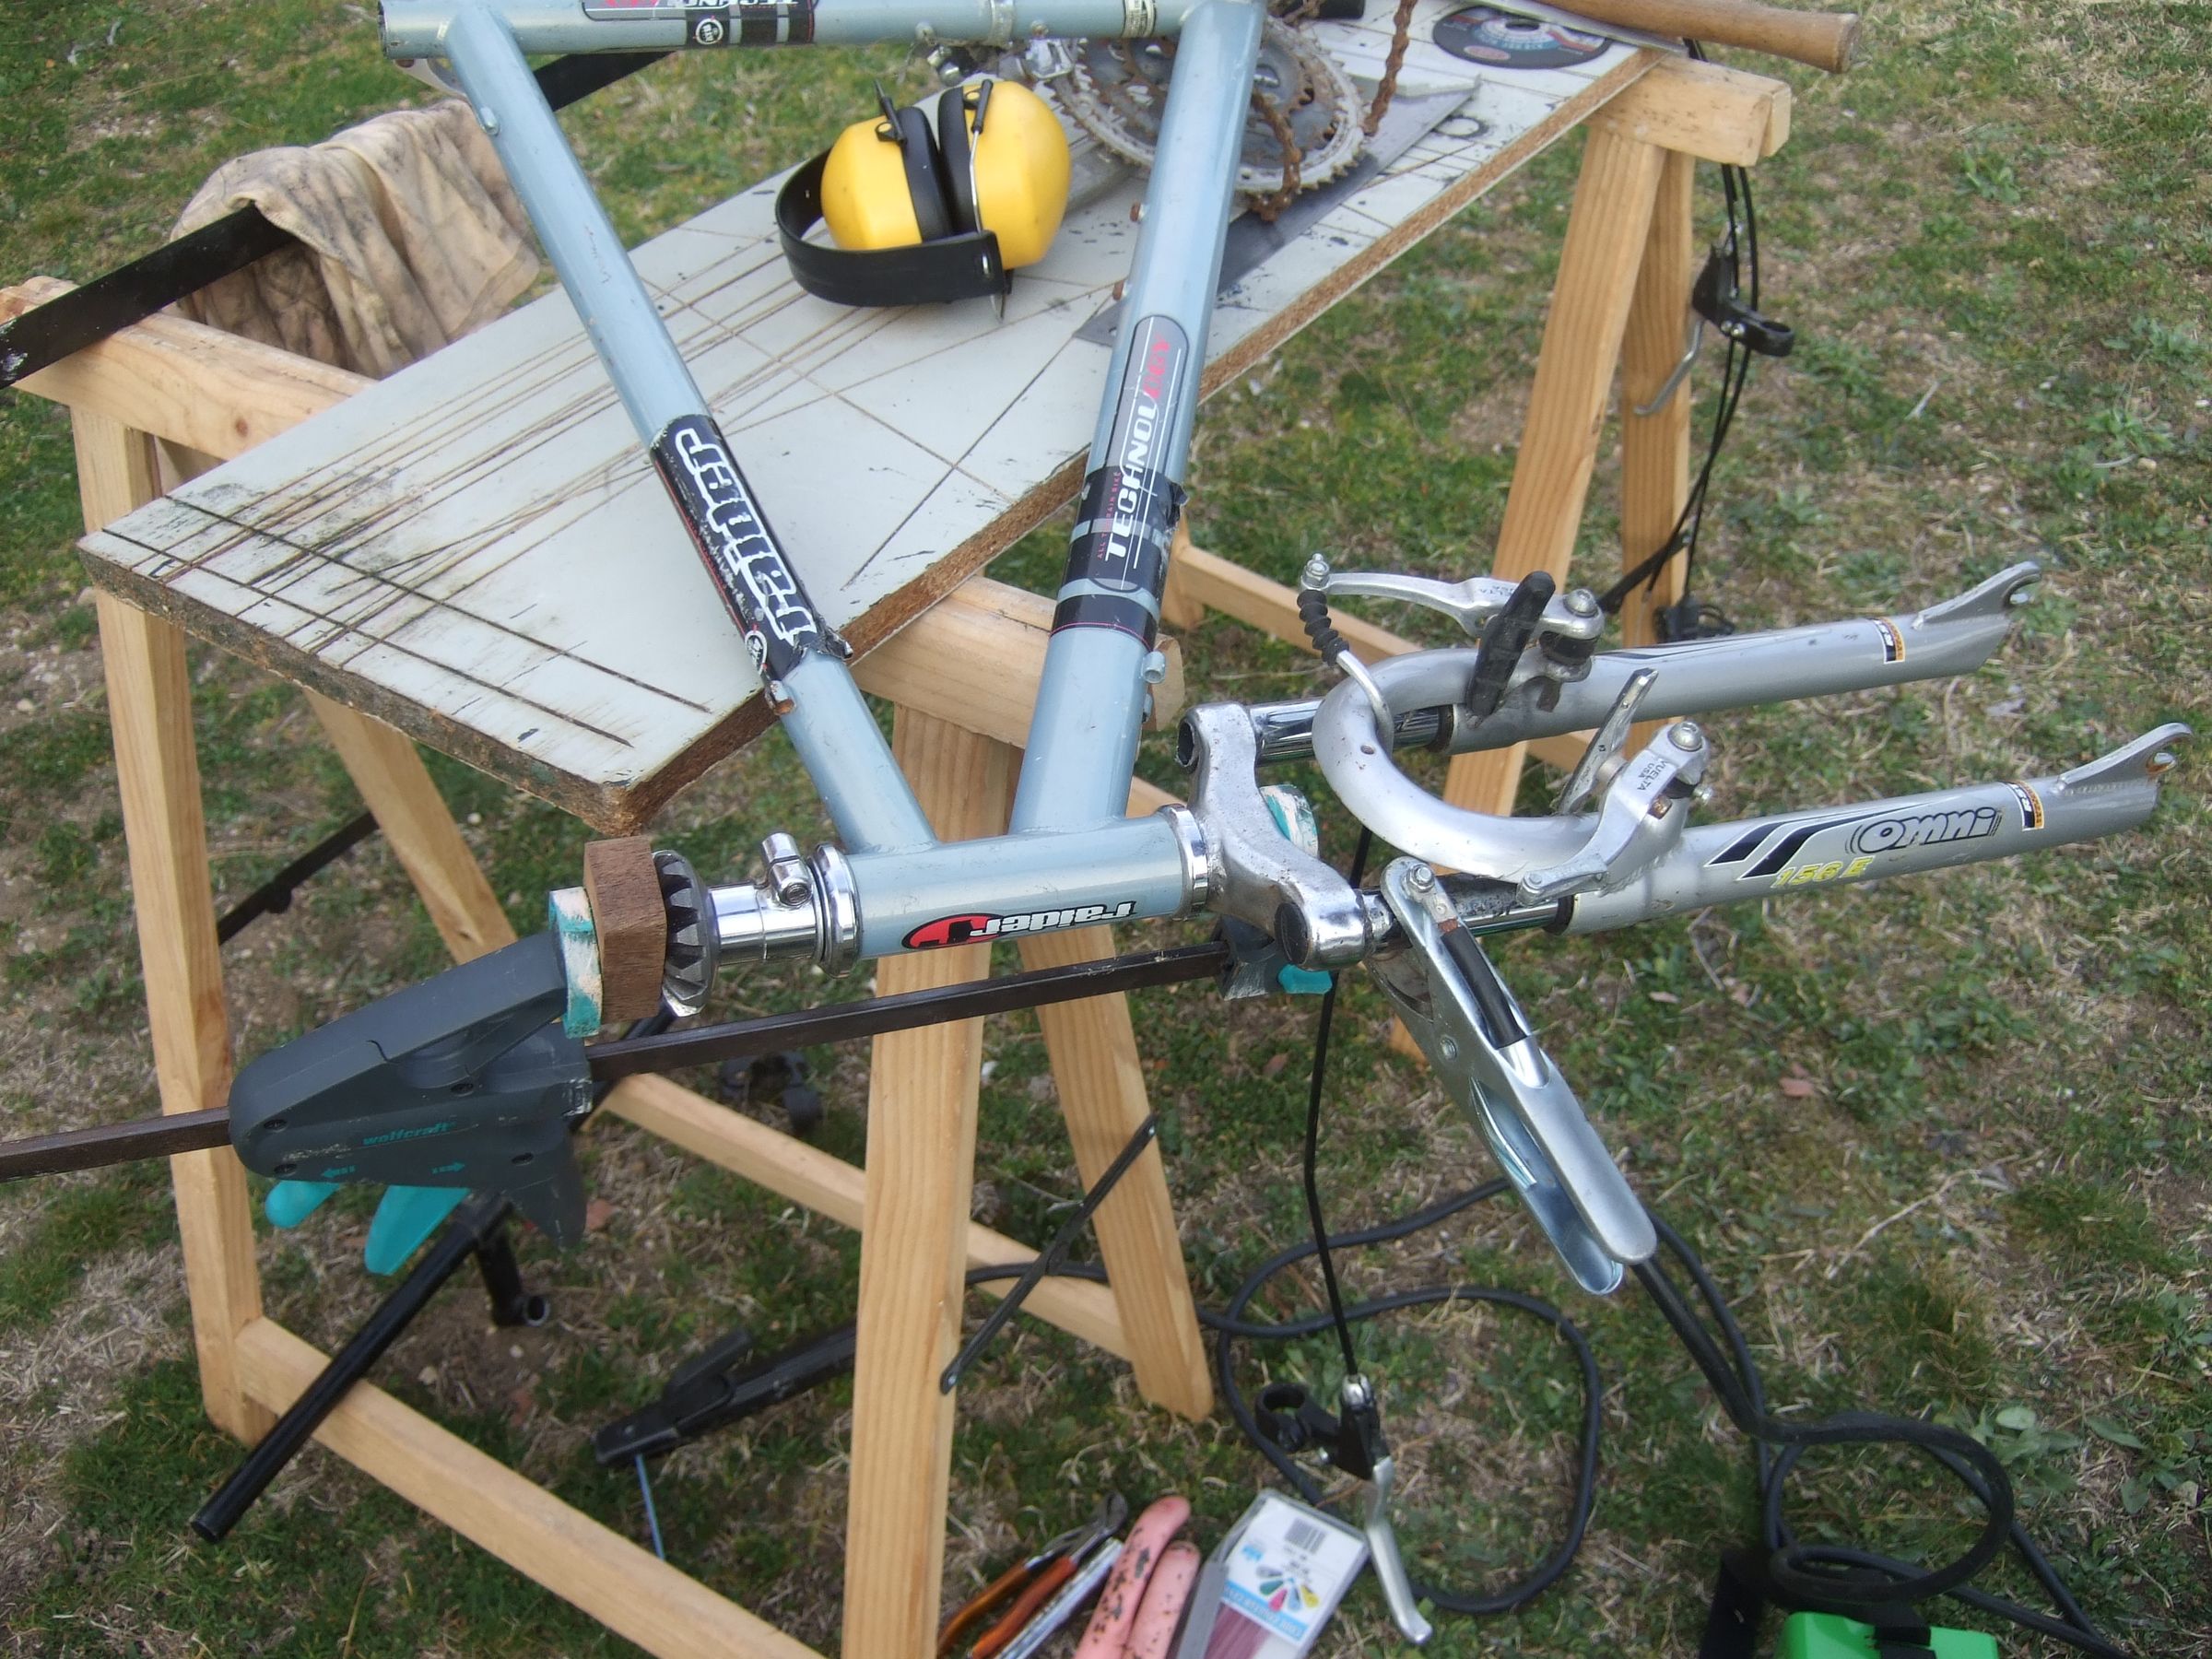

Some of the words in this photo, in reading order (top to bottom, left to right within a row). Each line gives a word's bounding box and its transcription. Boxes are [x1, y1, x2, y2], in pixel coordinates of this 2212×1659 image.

[676, 428, 818, 646] raider
[1637, 761, 1654, 778] USA
[1637, 759, 1666, 791] VUELTA
[1856, 806, 1998, 853] Omni
[969, 900, 1136, 936] raider
[363, 1123, 449, 1146] wolfcraft
